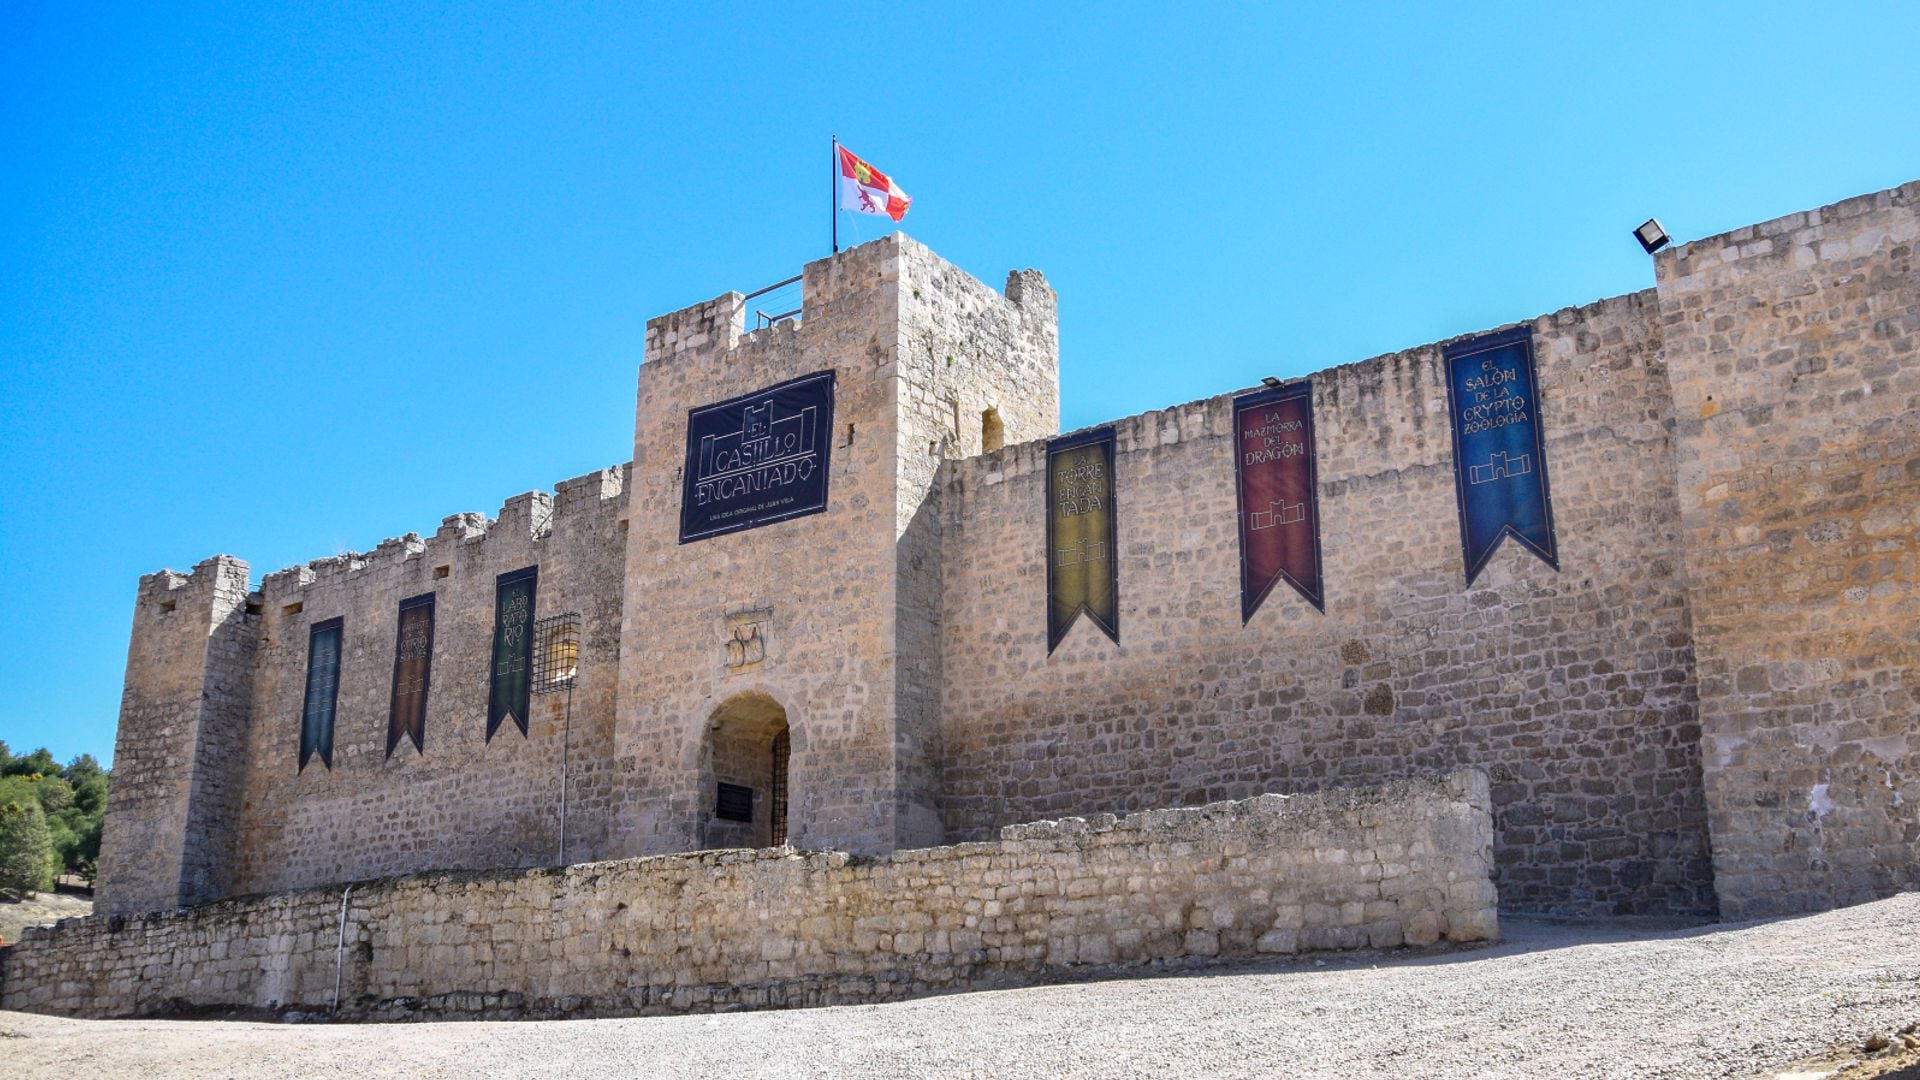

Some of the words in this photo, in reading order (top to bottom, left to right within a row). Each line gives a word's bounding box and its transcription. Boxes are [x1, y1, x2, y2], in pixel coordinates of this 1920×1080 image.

[1481, 360, 1497, 372] EL
[1465, 368, 1516, 392] SALÓN
[1475, 390, 1490, 402] DE
[1493, 386, 1510, 398] LA
[1265, 412, 1280, 424] LA
[1463, 395, 1525, 421] CRYPTO
[750, 422, 766, 437] EL
[1244, 420, 1303, 440] MAZMORRA
[1264, 435, 1281, 448] DEL
[716, 432, 796, 472] CASTILLO
[1073, 455, 1087, 467] LA
[697, 457, 814, 506] ENCANTADO
[1058, 463, 1103, 485] TORRE
[1059, 496, 1103, 517] TADA
